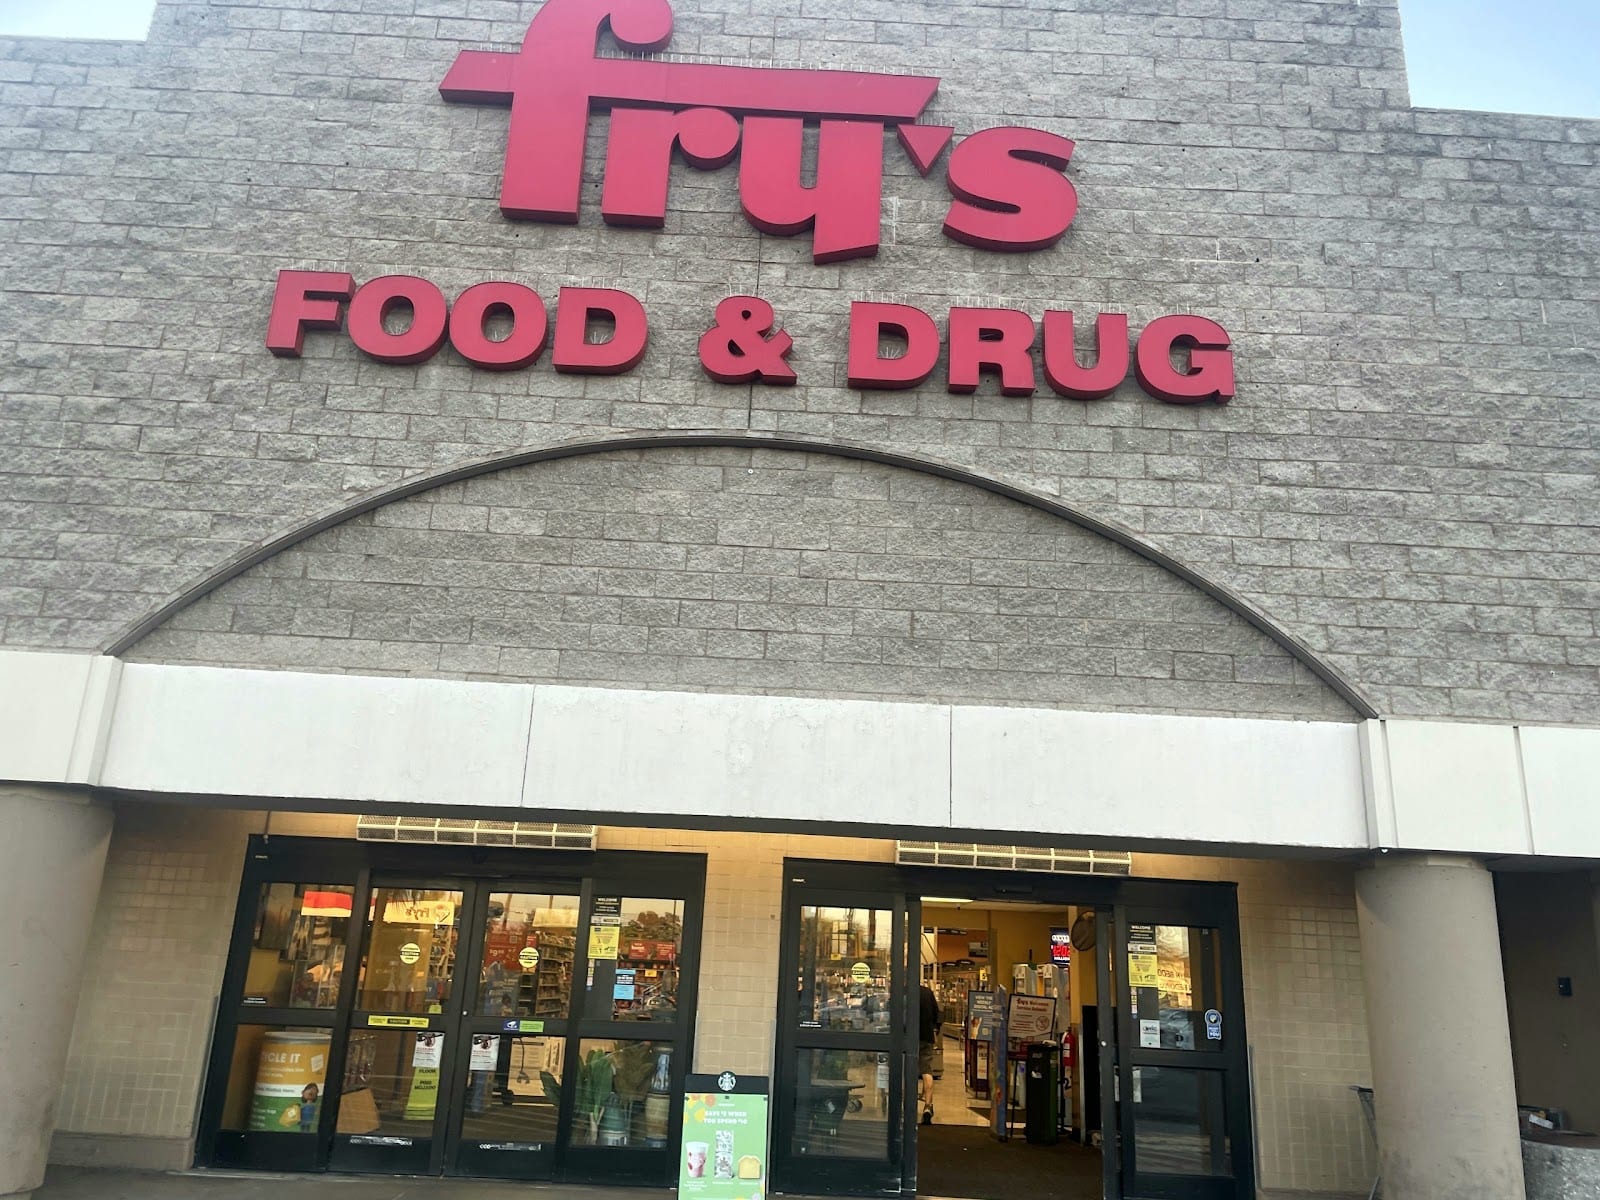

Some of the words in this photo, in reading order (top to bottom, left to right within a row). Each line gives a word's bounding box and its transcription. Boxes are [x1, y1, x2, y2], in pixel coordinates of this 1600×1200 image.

[440, 0, 1077, 264] fry's
[266, 269, 649, 374] FOOD
[698, 295, 795, 385] &
[847, 300, 1236, 404] DRUG
